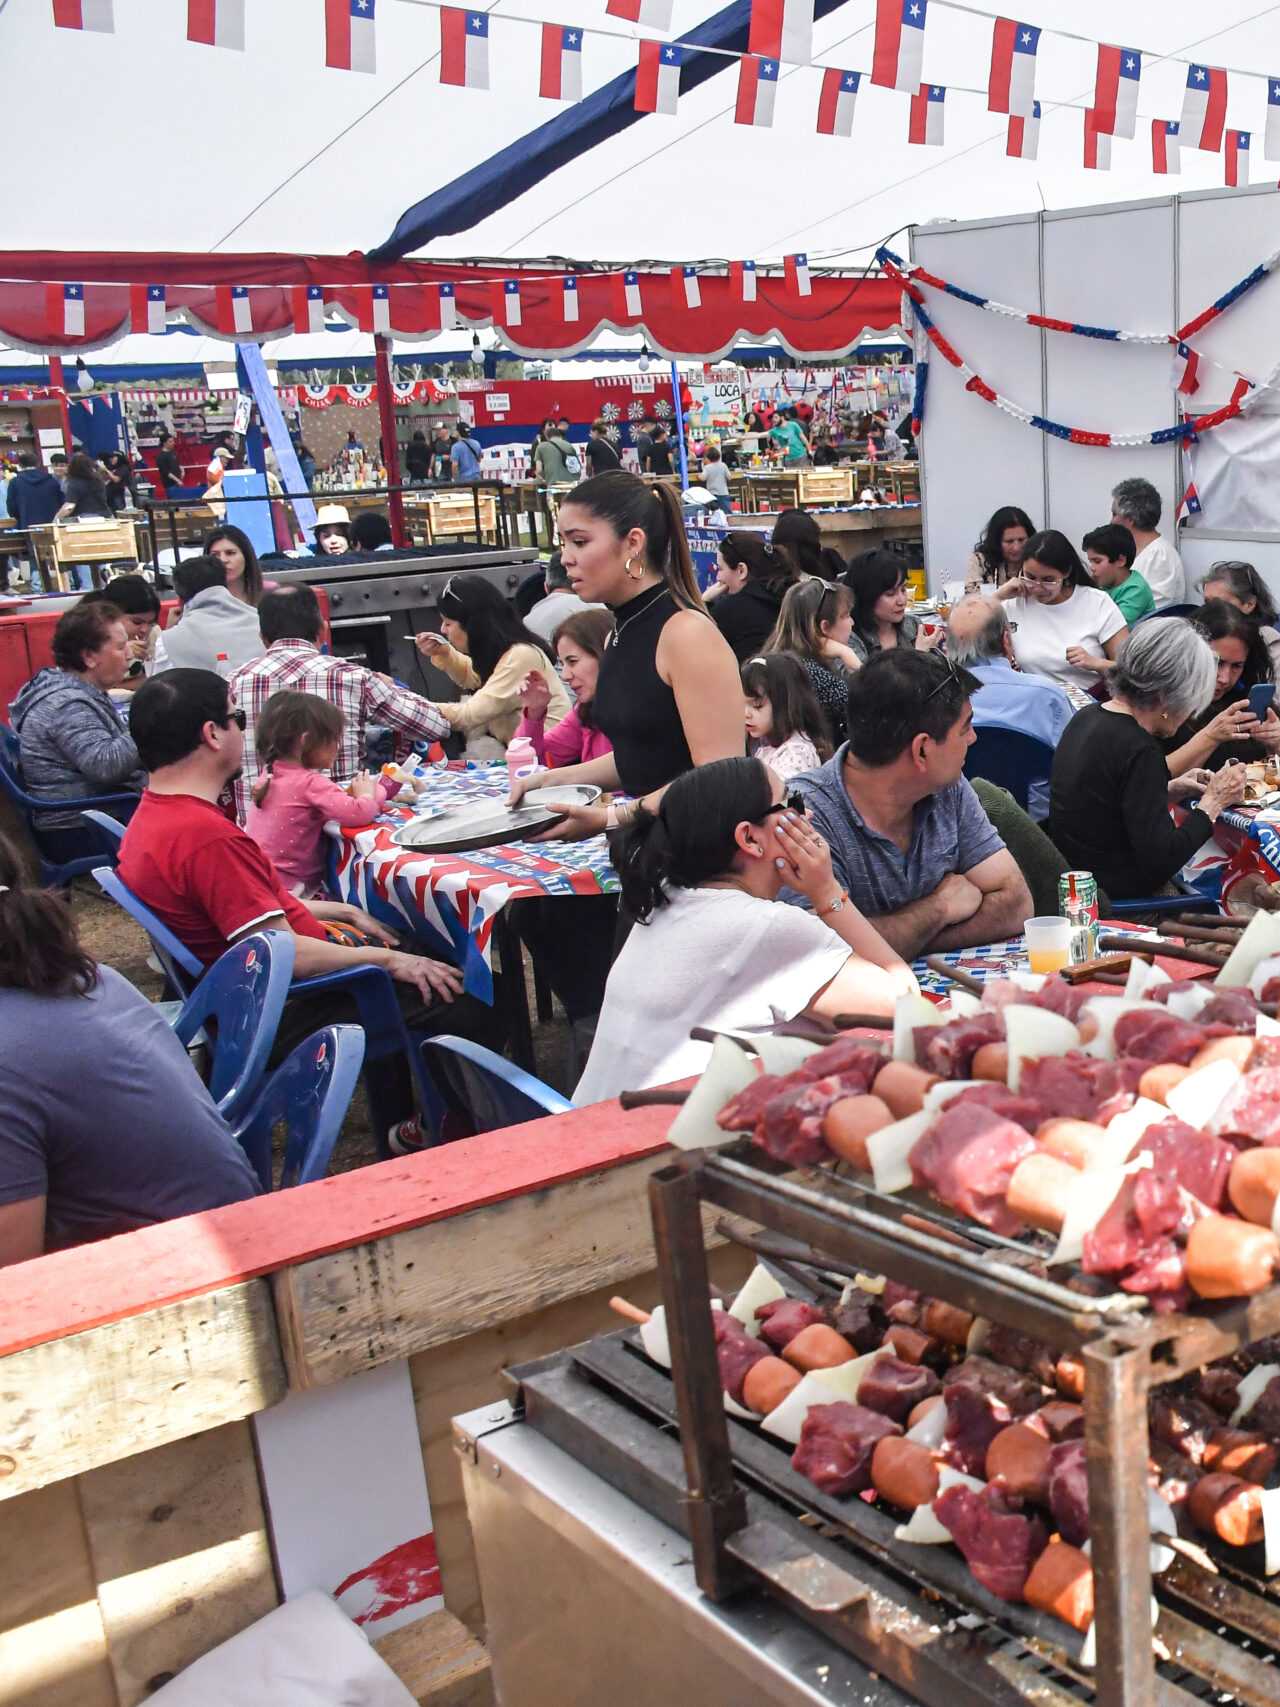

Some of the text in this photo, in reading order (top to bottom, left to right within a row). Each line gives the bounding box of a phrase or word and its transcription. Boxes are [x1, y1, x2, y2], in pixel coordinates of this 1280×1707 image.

[715, 384, 740, 397] LOCA
[305, 397, 331, 408] CHILE
[347, 397, 372, 408] CHILE
